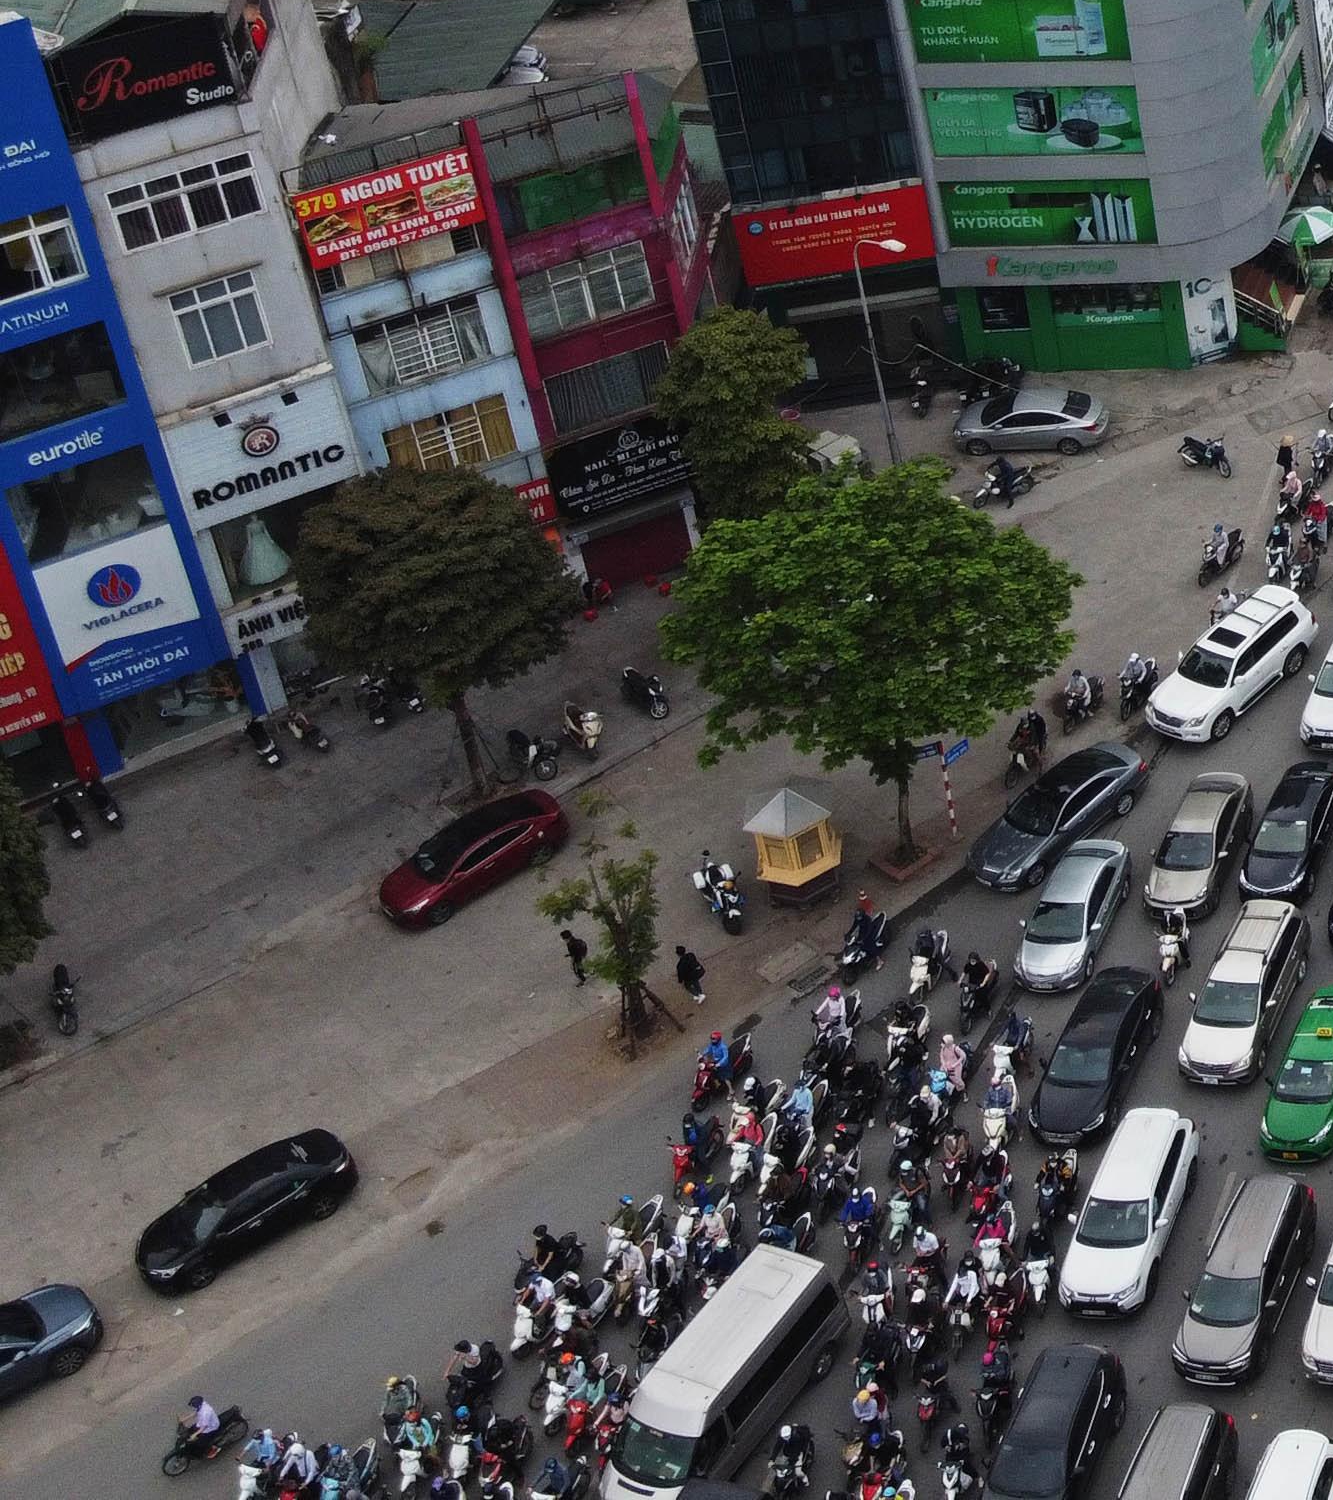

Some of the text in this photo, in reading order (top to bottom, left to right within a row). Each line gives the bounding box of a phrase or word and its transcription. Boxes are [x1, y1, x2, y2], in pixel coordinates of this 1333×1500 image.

[77, 55, 217, 112] Romantic
[186, 85, 235, 106] Studio
[295, 152, 470, 218] 379 NGON TUYỆT
[316, 234, 363, 257] BÁNH
[366, 225, 388, 242] MÌ
[392, 214, 430, 234] LINH
[953, 215, 1044, 230] HYDROGEN
[28, 429, 103, 466] eurotile
[192, 444, 346, 511] ROMANTIC
[83, 596, 165, 632] VIGLACERA
[93, 670, 123, 688] TÂN
[125, 657, 161, 680] THỜI
[163, 645, 190, 665] ĐẠI
